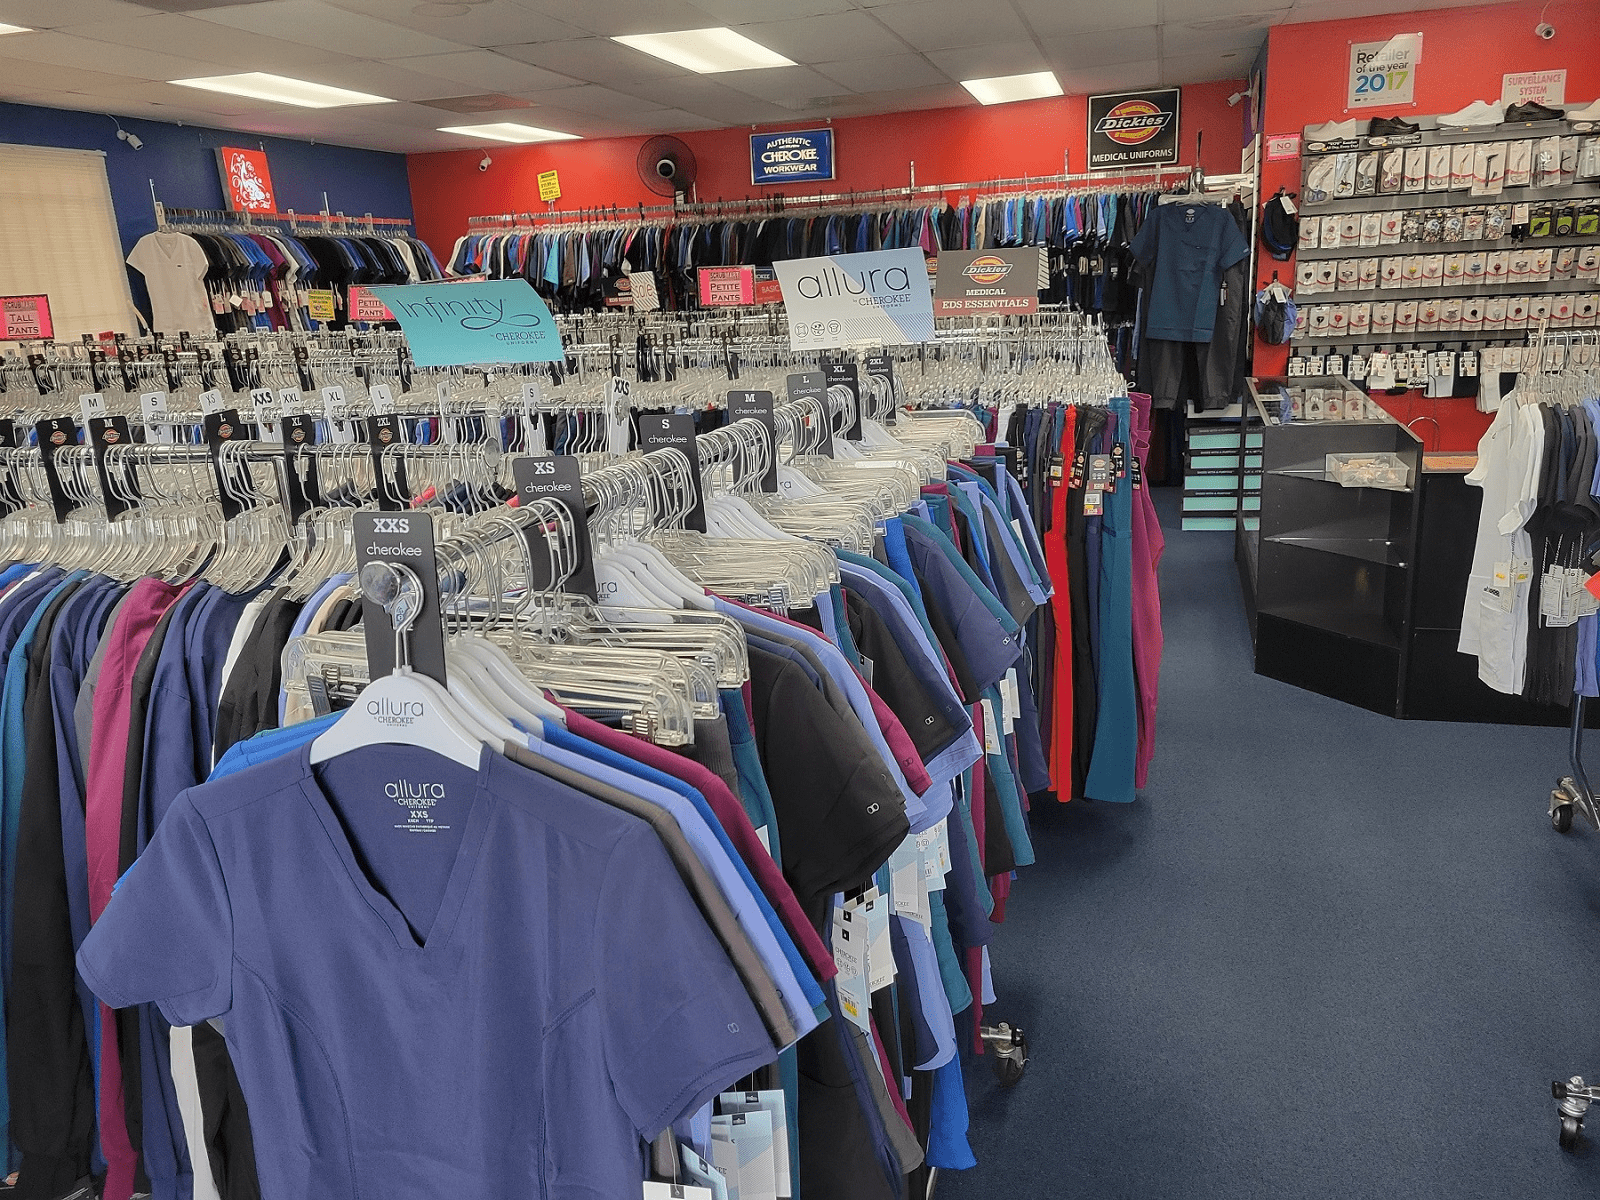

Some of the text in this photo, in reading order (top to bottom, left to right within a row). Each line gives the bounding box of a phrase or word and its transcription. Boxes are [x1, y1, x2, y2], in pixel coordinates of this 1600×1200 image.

[1387, 62, 1408, 72] year
[1355, 71, 1408, 93] 2017
[1508, 74, 1562, 86] SURVEILLANCE
[1520, 87, 1547, 95] SYSTEM
[1102, 116, 1164, 129] Dickies
[767, 137, 811, 149] AUTHENTIC
[1276, 142, 1292, 150] NO
[761, 149, 817, 162] CHEROKEE
[1092, 149, 1172, 162] MEDICAL UNIFORMS
[764, 164, 816, 174] WORKWEAR
[710, 283, 740, 291] PETITE
[798, 267, 910, 298] allura
[859, 294, 911, 306] CHEROKEE
[942, 299, 1029, 309] EDS ESSENTIALS
[10, 314, 34, 322] TALL
[396, 297, 540, 330] Infinity
[8, 326, 39, 334] PANTS
[496, 331, 545, 340] CHEROKEE
[614, 379, 629, 395] XXS
[329, 392, 340, 401] XL
[379, 391, 385, 400] L
[530, 388, 535, 397] S
[88, 399, 98, 407] M
[151, 398, 158, 406] S
[205, 394, 215, 405] XS
[252, 394, 273, 405] XXS
[284, 394, 299, 403] XXL
[745, 394, 755, 403] M
[734, 407, 768, 415] cherokee
[52, 421, 59, 430] S
[104, 419, 114, 428] M
[292, 418, 302, 426] XL
[377, 418, 391, 427] 2XL
[661, 419, 670, 429] S
[648, 434, 687, 444] cherokee
[534, 462, 556, 475] XS
[525, 482, 571, 493] cherokee
[373, 519, 410, 533] XXS
[366, 542, 422, 557] cherokee
[367, 697, 424, 717] allura
[378, 716, 414, 724] CHEROKEE
[384, 779, 446, 798] allura
[398, 798, 437, 806] CHEROKEE
[410, 810, 429, 818] XXS
